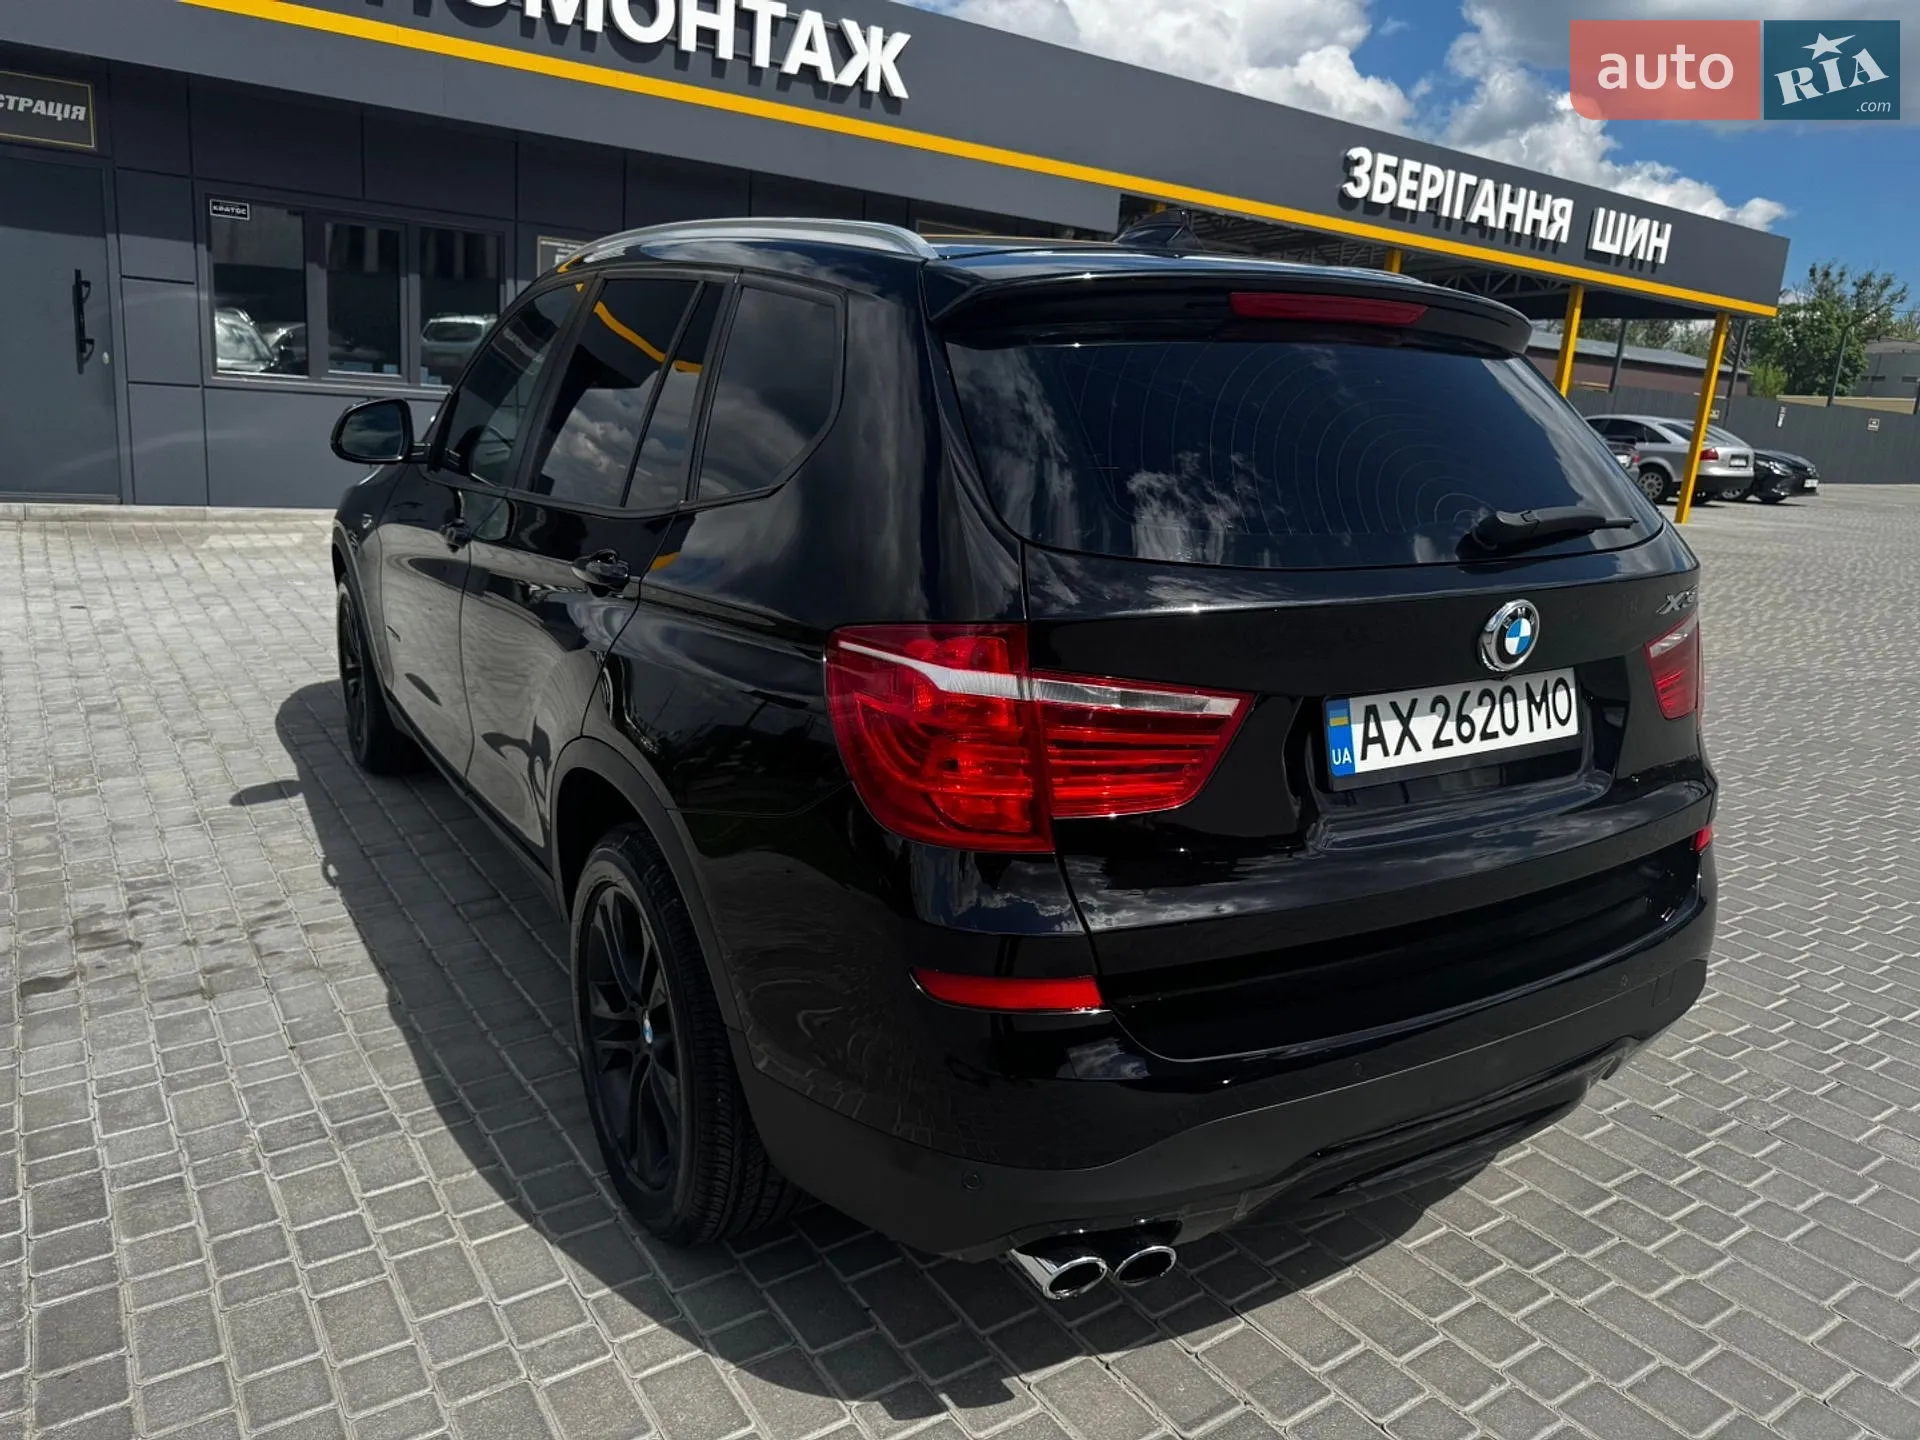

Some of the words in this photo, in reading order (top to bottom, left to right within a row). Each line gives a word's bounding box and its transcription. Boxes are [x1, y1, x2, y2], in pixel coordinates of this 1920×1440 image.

[466, 0, 911, 99] ОНТАЖ
[1342, 146, 1574, 244] ЗБЕРІГАННЯ
[1592, 206, 1672, 264] ШИН
[1331, 750, 1353, 766] UA
[1360, 698, 1422, 761] AX
[1430, 685, 1519, 749] 2620
[1525, 677, 1572, 732] MO
